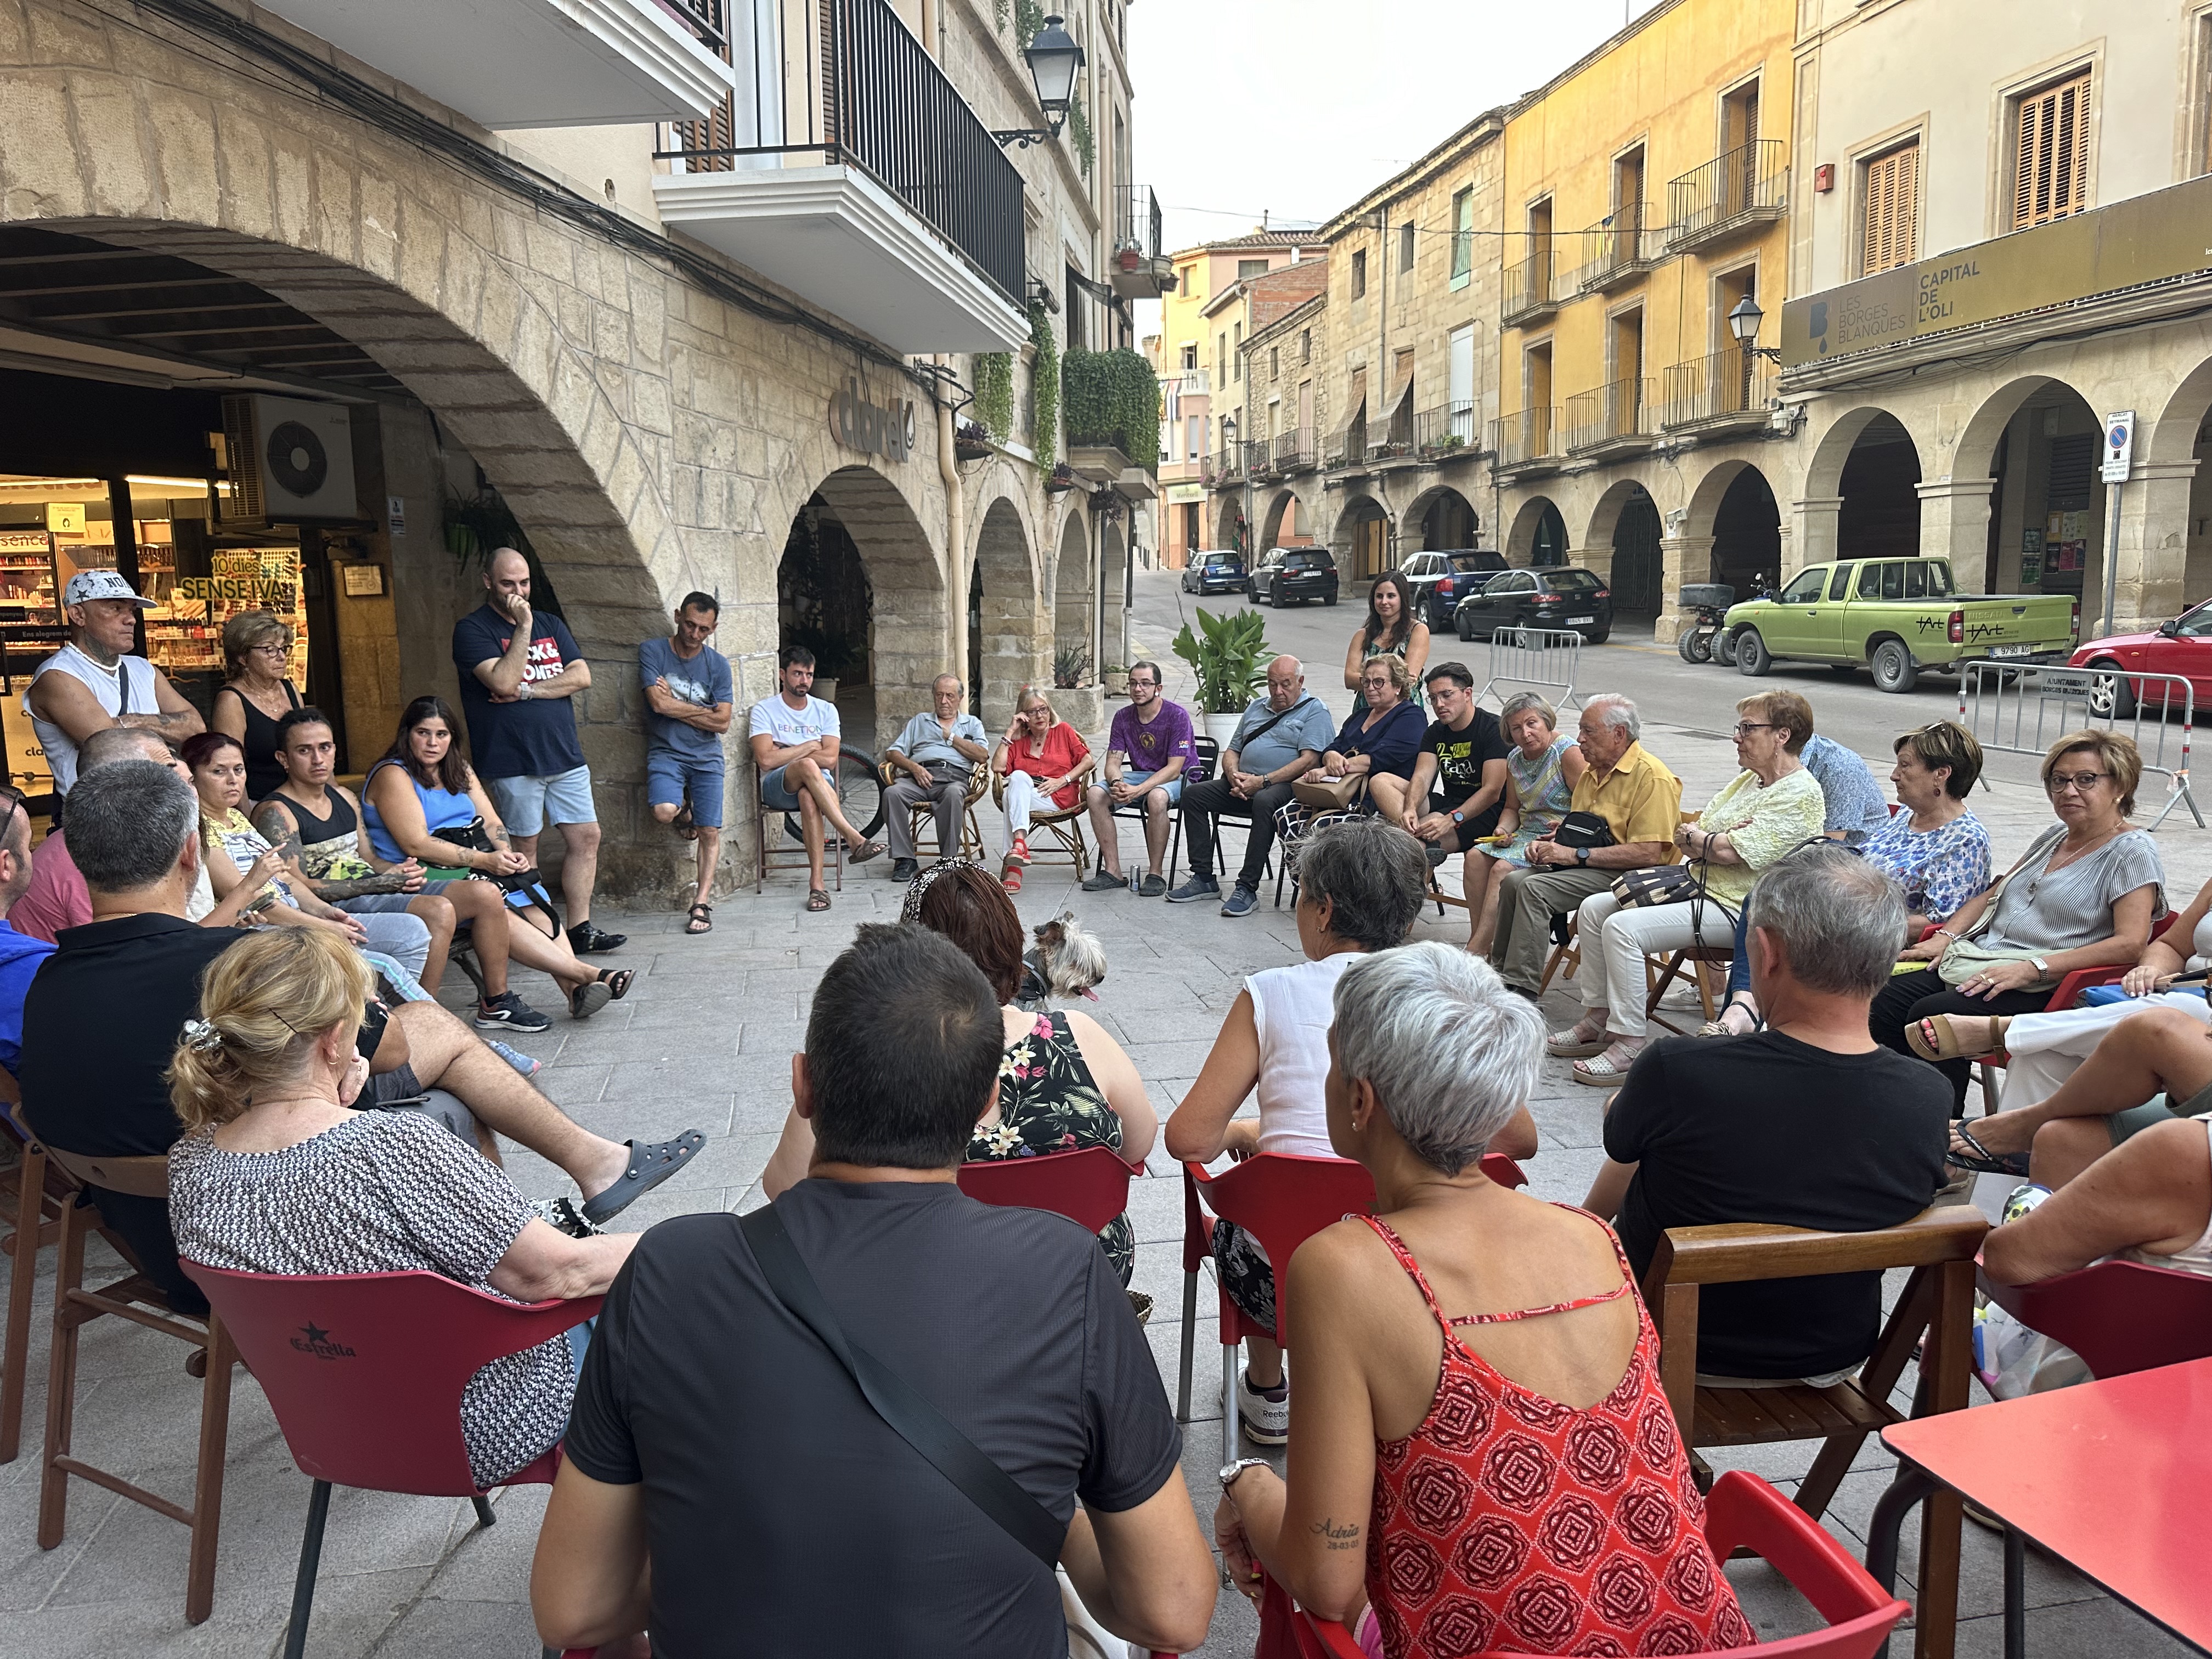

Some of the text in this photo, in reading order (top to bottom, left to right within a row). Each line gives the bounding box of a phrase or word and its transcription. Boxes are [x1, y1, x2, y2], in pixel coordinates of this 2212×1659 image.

[1920, 261, 1980, 289] CAPITAL
[1839, 295, 1861, 313] LES
[1920, 289, 1938, 306] DE
[1839, 303, 1888, 329] BORGES
[1838, 314, 1906, 344] BLANQUES
[828, 375, 909, 464] clarel
[213, 557, 260, 573] 10 dies
[181, 578, 246, 600] SENSE
[250, 578, 285, 600] IVA
[1968, 611, 2003, 620] NISSAN
[1993, 645, 2029, 656] L 9790 AG
[523, 662, 564, 681] ONES
[2047, 678, 2086, 687] AJUNTAMENT
[778, 724, 823, 734] BENETTON
[25, 747, 44, 756] cla
[290, 1338, 357, 1357] Estrella
